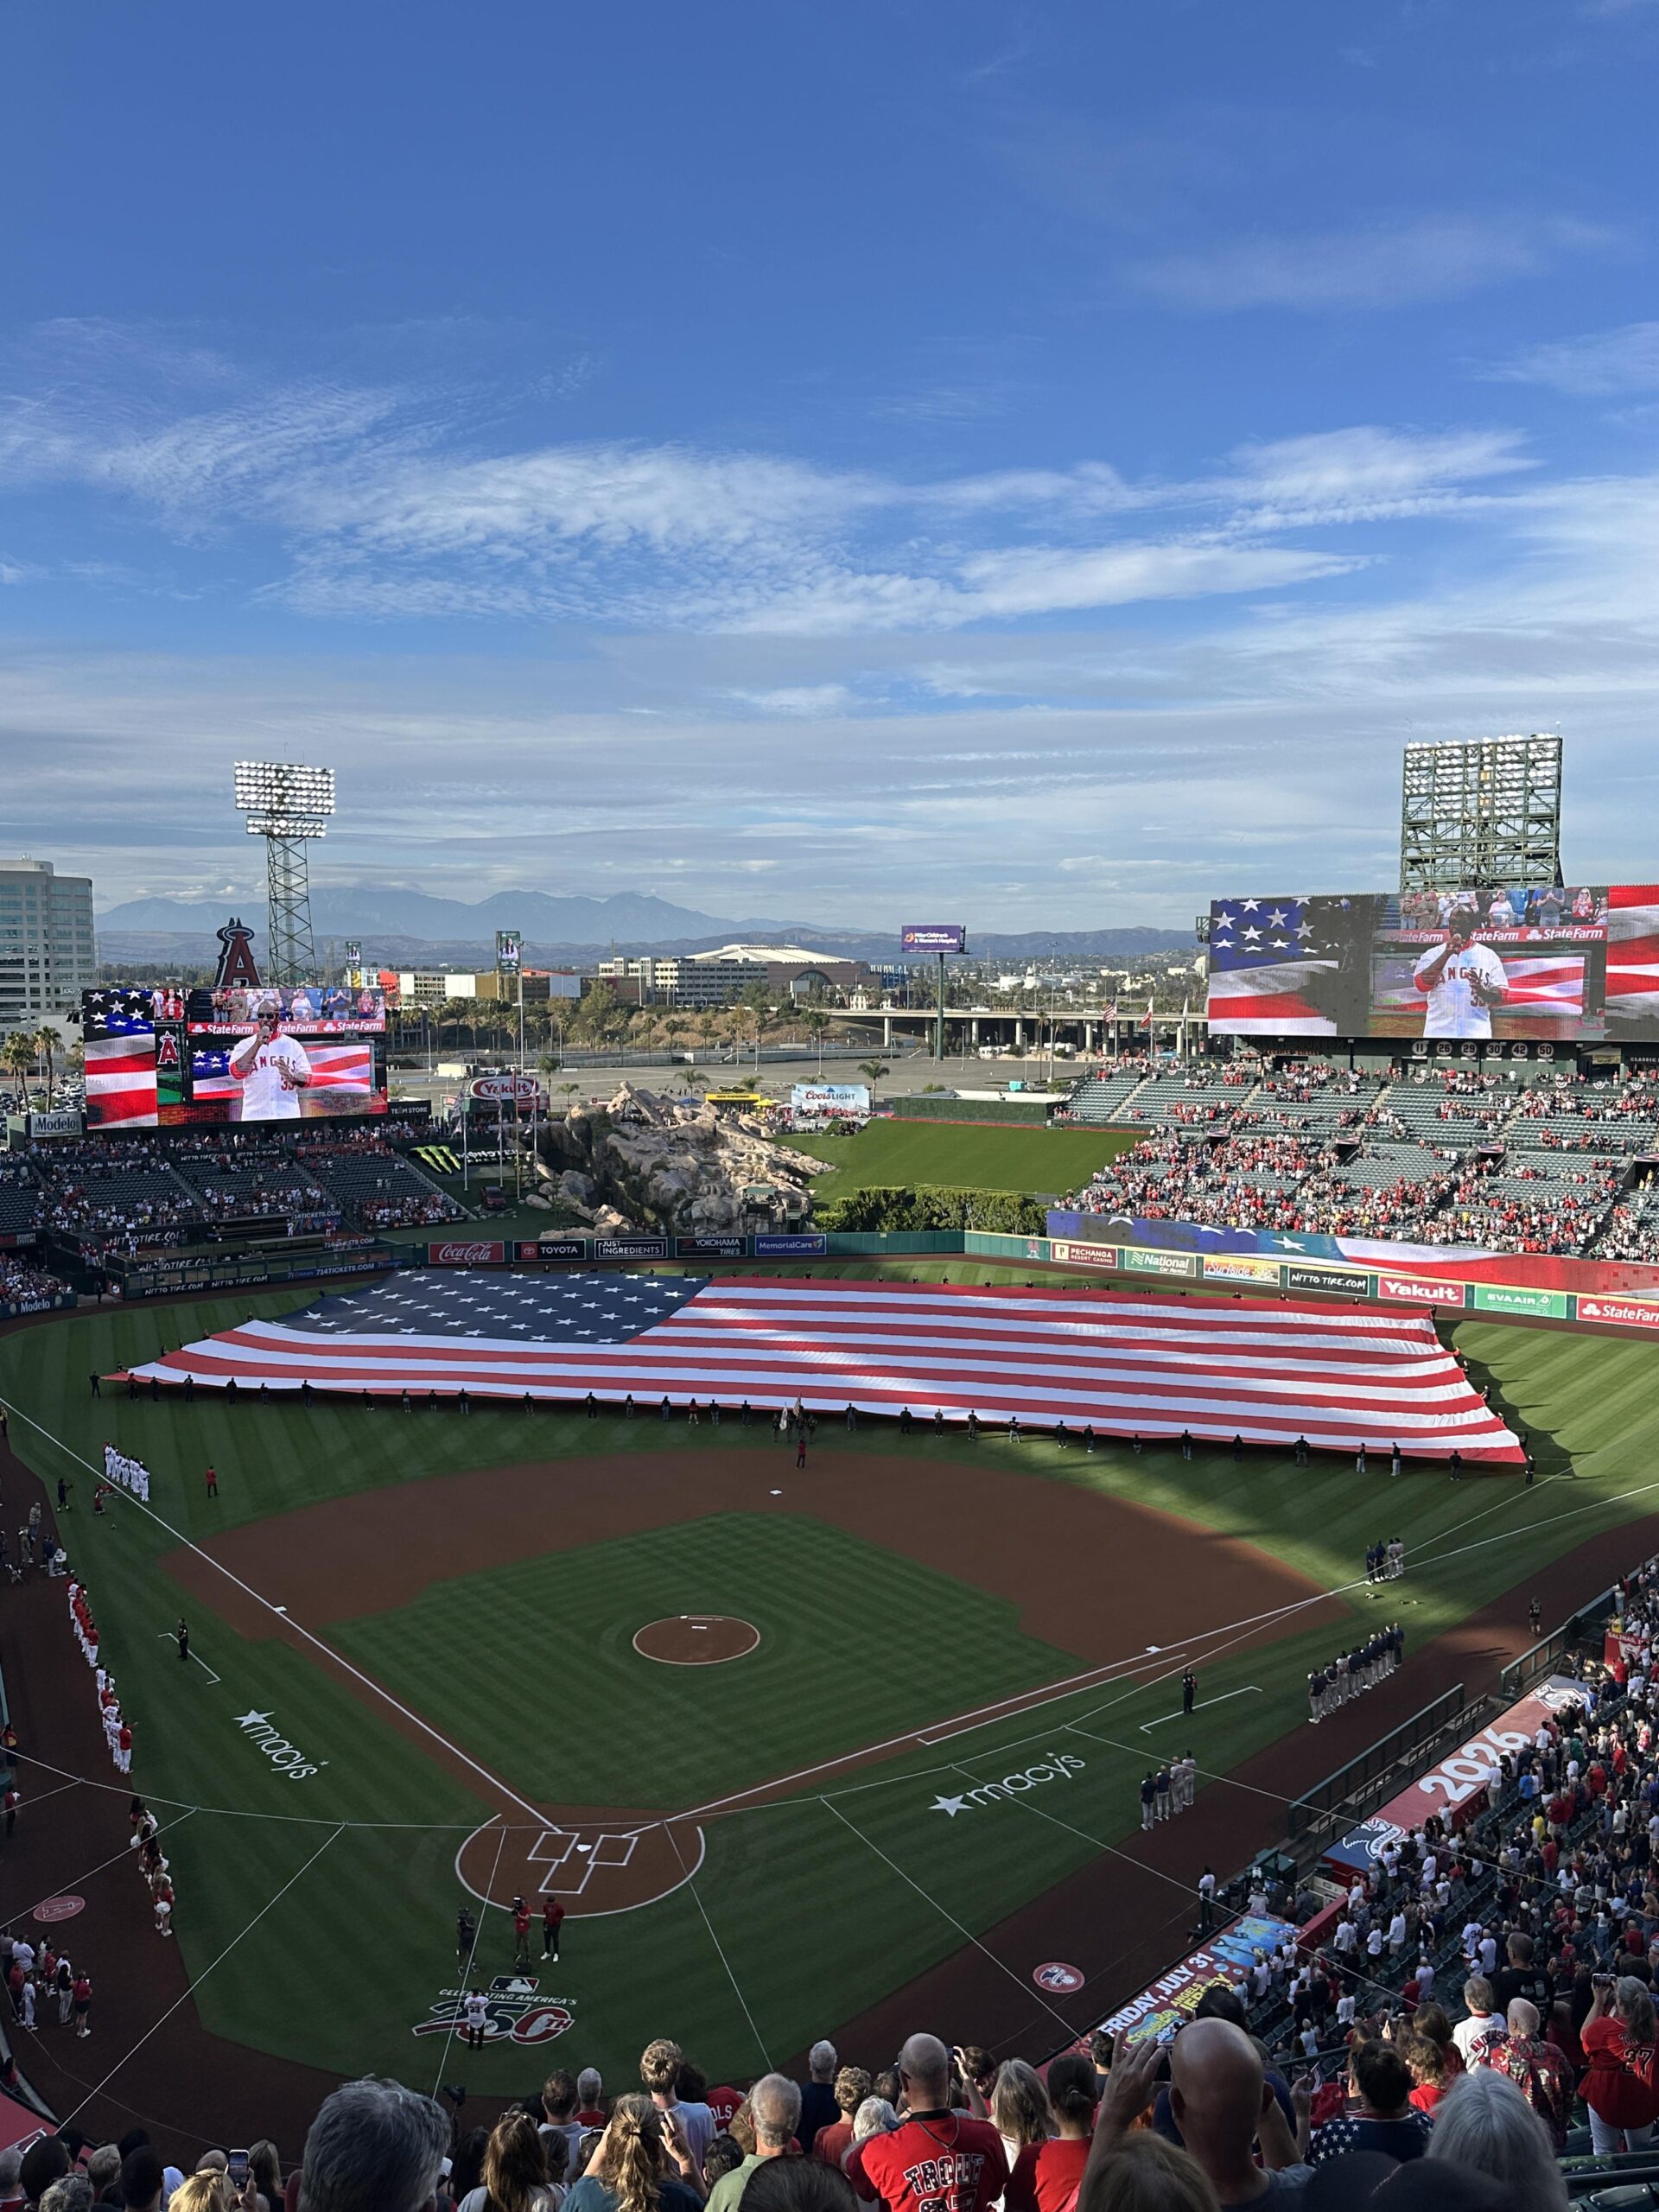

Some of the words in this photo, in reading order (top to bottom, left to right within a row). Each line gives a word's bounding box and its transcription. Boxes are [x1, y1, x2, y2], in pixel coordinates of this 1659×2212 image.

[1415, 1043, 1424, 1052] 11
[1438, 1043, 1451, 1052] 26
[1463, 1044, 1475, 1053] 29
[1488, 1045, 1500, 1053] 30
[1513, 1045, 1526, 1054] 42
[1539, 1046, 1552, 1054] 50
[805, 1090, 831, 1101] Coors
[38, 1116, 76, 1131] Modelo
[696, 1238, 741, 1247] YOKOHAMA
[759, 1242, 812, 1250] MemorialCare
[439, 1243, 493, 1262] Coca-Cola
[540, 1245, 578, 1255] TOYOTA
[602, 1245, 660, 1255] INGREDIENTS
[1071, 1248, 1113, 1258] PECHANGA
[1144, 1254, 1189, 1269] National
[316, 1263, 375, 1276] 714TICKETS.COM
[1207, 1262, 1250, 1276] Surfside
[212, 1279, 233, 1288] NITTO
[1291, 1272, 1319, 1284] NITTO
[1322, 1276, 1366, 1289] TIRE.COM
[145, 1287, 168, 1296] NITTO
[1384, 1281, 1457, 1301] Yakult
[21, 1299, 50, 1313] Modelo
[1419, 1728, 1531, 1802] 2026
[1188, 1952, 1215, 1969] 31
[438, 1988, 514, 2000] CELETING
[514, 1994, 579, 2005] AMERICA'S
[1170, 1982, 1203, 2007] ANGELS
[1621, 2047, 1656, 2077] 27
[903, 2152, 985, 2196] TROUT
